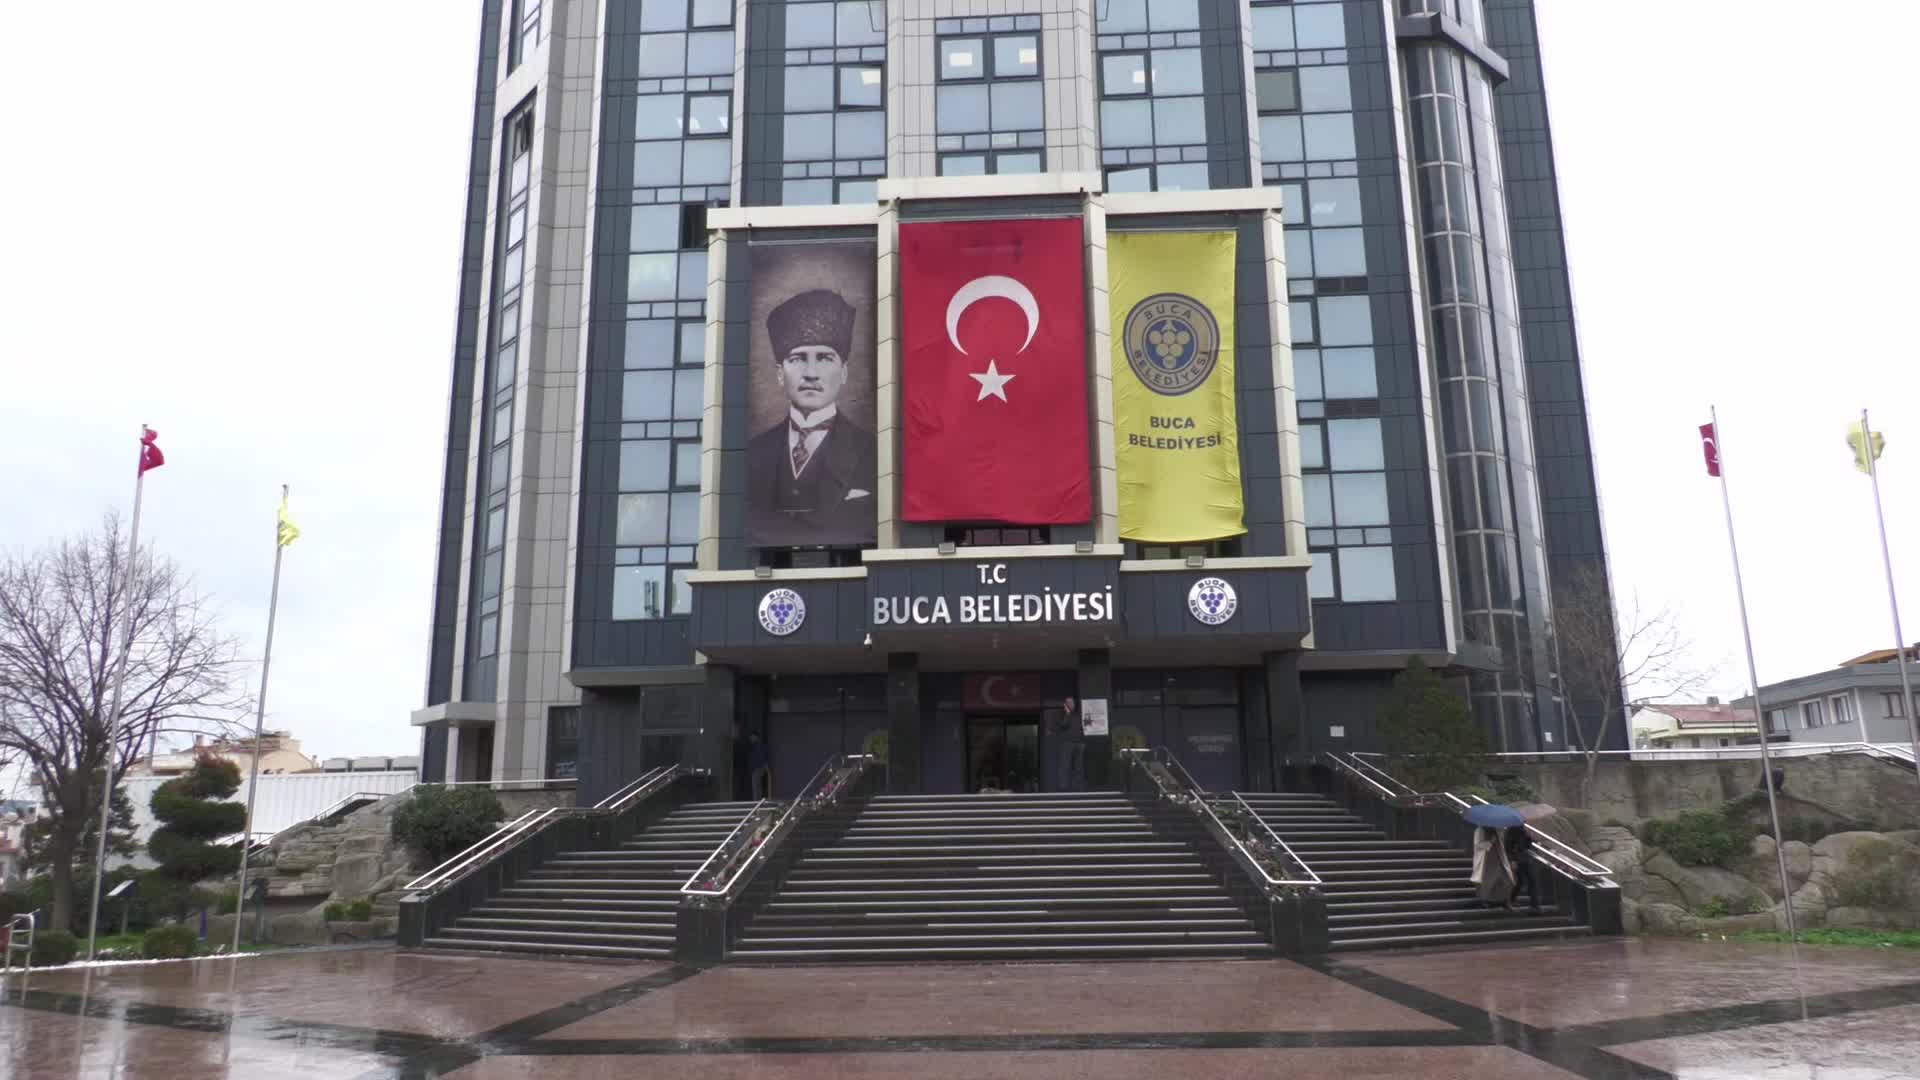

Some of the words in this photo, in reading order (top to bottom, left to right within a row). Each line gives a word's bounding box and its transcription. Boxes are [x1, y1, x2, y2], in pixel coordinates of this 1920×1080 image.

[1144, 304, 1192, 320] BUCA
[1150, 416, 1196, 429] BUCA
[1129, 432, 1222, 450] BELEDİYESİ
[977, 564, 1006, 584] T.C
[1197, 579, 1225, 589] BUCA
[873, 596, 952, 624] BUCA
[959, 585, 1113, 623] BELEDİYESİ
